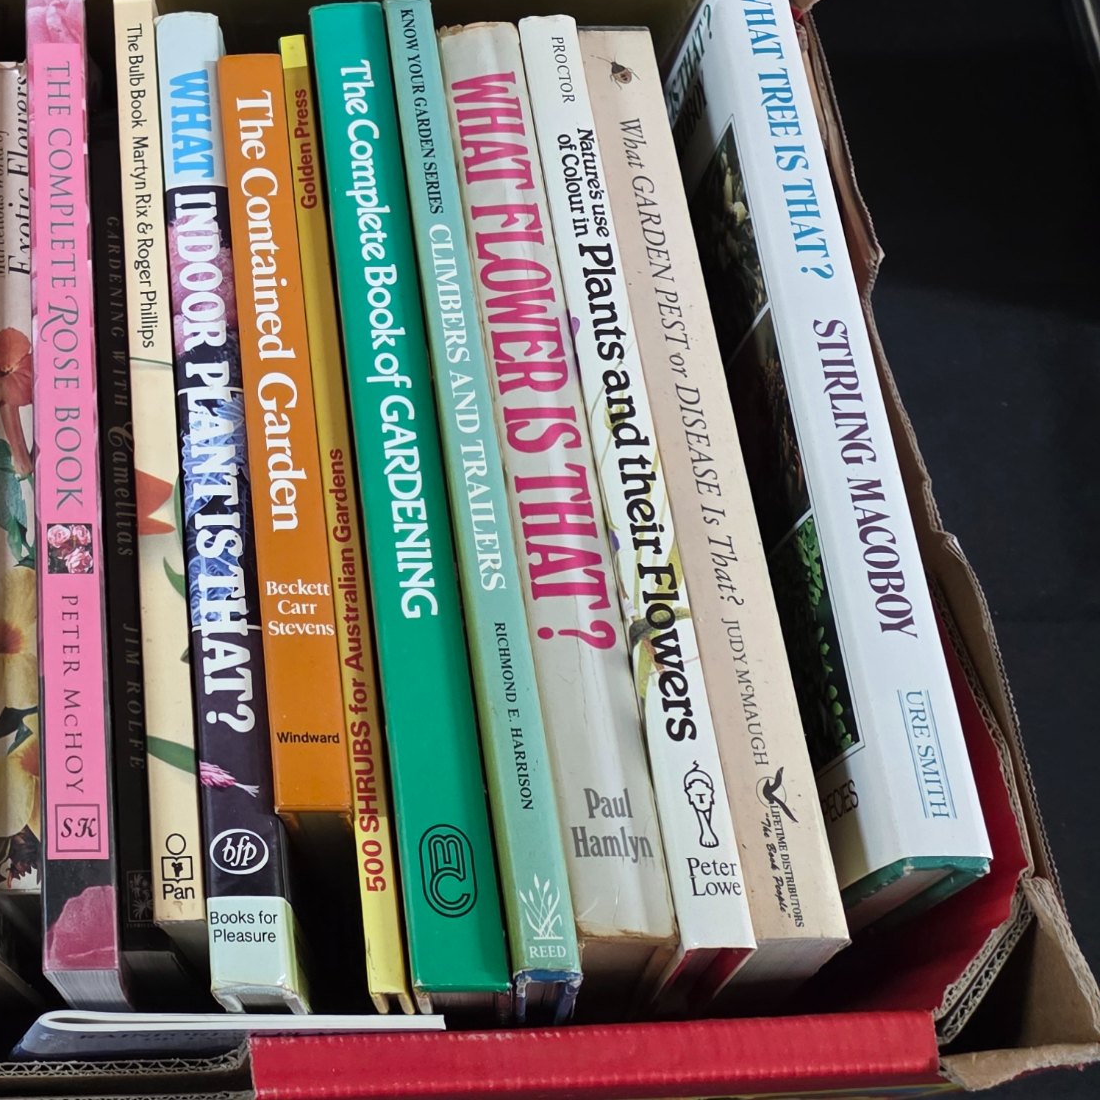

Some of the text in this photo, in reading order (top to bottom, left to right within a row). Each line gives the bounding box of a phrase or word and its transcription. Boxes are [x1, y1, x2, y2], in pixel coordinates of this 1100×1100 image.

[401, 9, 445, 214] KNOW YOUR GARDEN SERIES
[551, 36, 576, 104] PROCTOR
[758, 67, 804, 138] TREE
[127, 23, 157, 348] The Bulb Book Martyn Rix Roger Phillips
[294, 89, 317, 210] Golden Press
[577, 128, 611, 238] Nature's use
[773, 144, 809, 173] IS
[40, 61, 84, 510] THE COMPLETE ROSE BOOK
[451, 71, 583, 453] WHAT FLOWER IS
[783, 178, 835, 280] THAT?
[236, 90, 307, 532] The Contained Garden
[341, 59, 438, 620] The Complete Book of GARDENING
[619, 118, 745, 606] What GARDEN PEST DISEASE That?
[169, 70, 256, 734] WHAT INDOOR PLANT IS THAT?
[429, 224, 508, 592] CLIMBERS AND TRAILERS
[561, 152, 697, 742] Colour Plants and their Flowers
[813, 319, 918, 640] STIRLING MACOBOY
[266, 579, 330, 597] Beckett
[268, 620, 335, 636] Stevens
[277, 600, 317, 615] Carr
[61, 595, 84, 794] PETER McHOY
[328, 448, 387, 892] 500 SHRUBS Australian Gardens
[494, 622, 534, 811] RICHMOND HARRISON
[721, 618, 770, 766] JUDY McMAUGH
[277, 731, 340, 744] Windward
[904, 690, 952, 820] URE SMITH
[571, 826, 654, 864] Hamlyn
[583, 787, 634, 819] Paul
[162, 884, 196, 900] Pan
[210, 910, 255, 926] Books
[686, 857, 737, 877] Peter
[691, 877, 742, 897] Lowe
[769, 802, 804, 928] LIFETIME DISTRIBUTORS
[213, 929, 277, 944] Pleasure
[528, 945, 566, 959] REED
